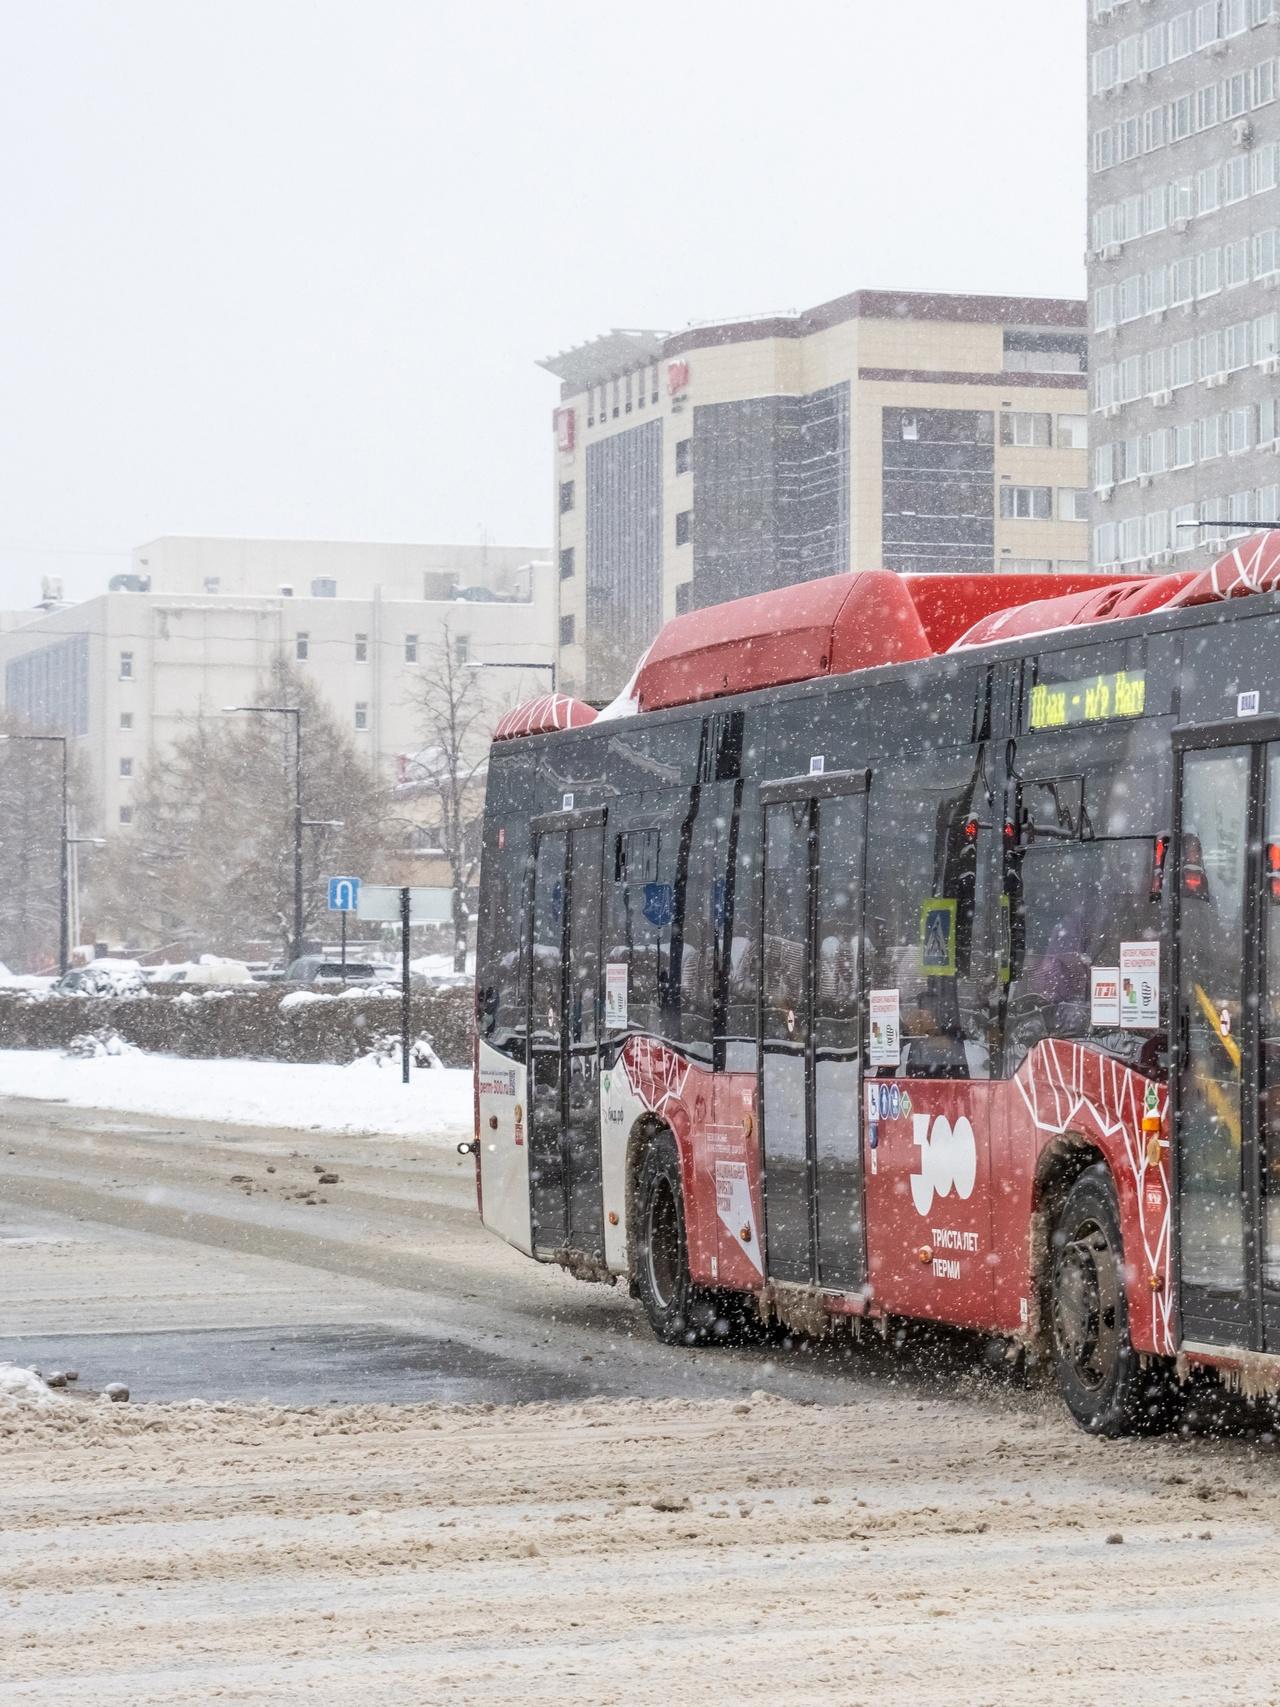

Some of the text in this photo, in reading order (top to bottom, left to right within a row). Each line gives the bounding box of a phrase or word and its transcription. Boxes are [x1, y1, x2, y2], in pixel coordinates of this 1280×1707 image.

[931, 1228, 979, 1252] ТРИСТА ЛЕТ
[932, 1258, 961, 1280] ПЕРМИ
